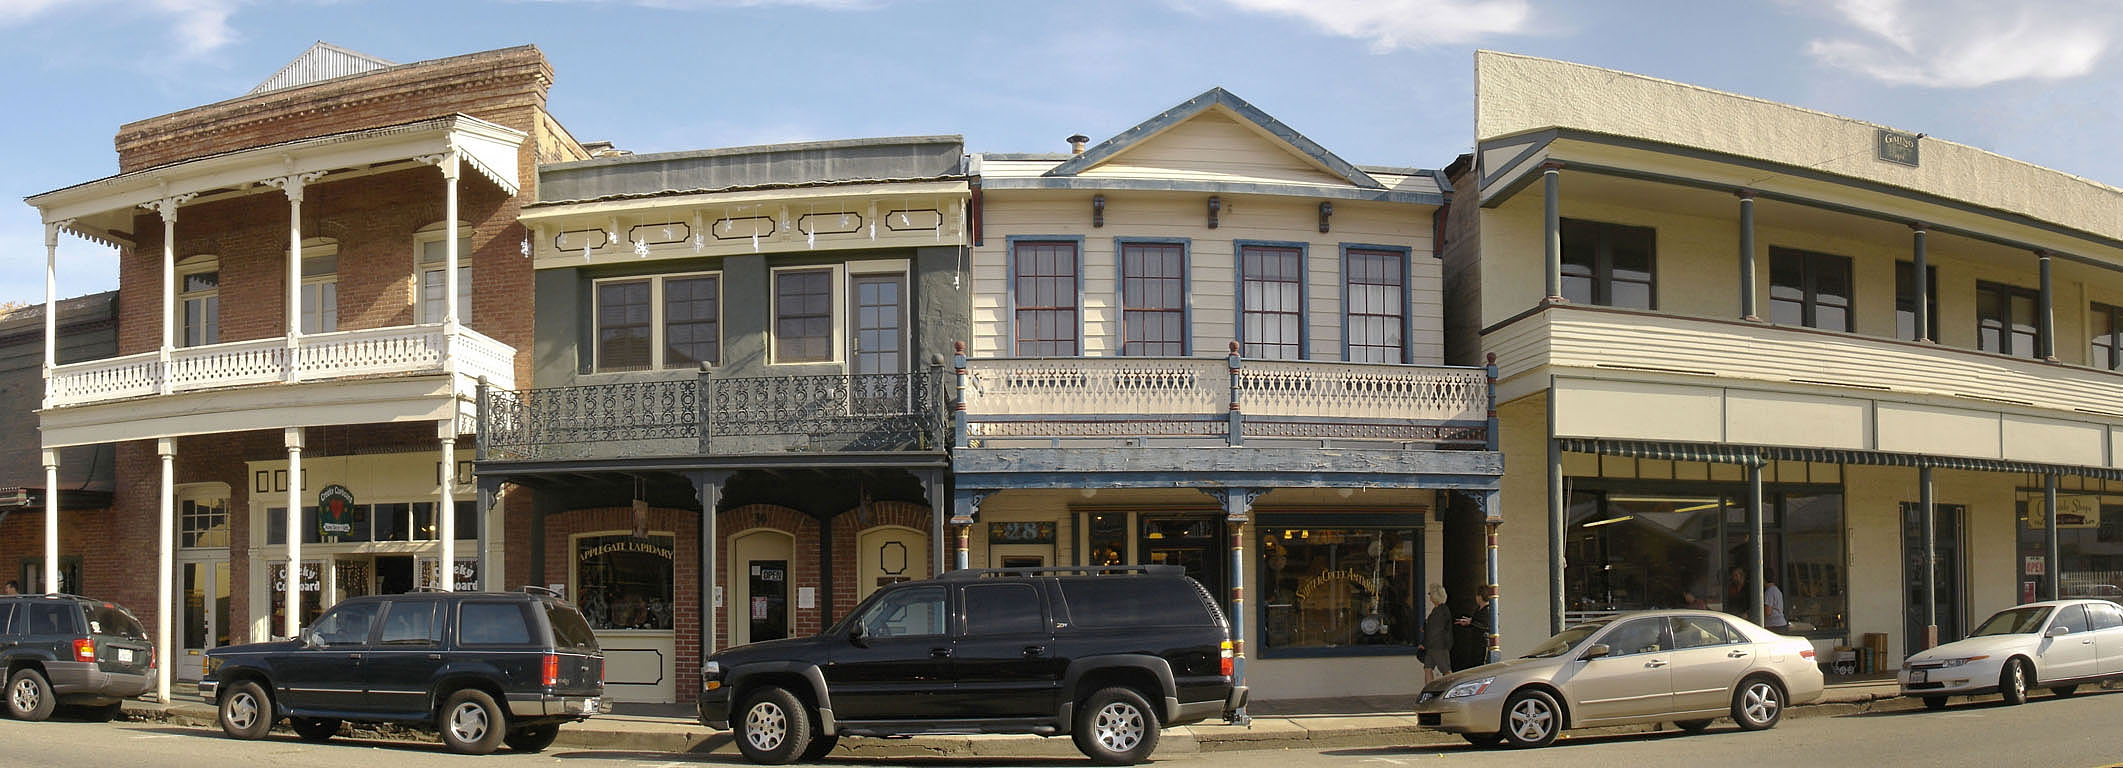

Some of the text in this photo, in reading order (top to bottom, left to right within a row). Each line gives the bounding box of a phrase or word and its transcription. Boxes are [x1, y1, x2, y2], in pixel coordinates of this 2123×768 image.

[580, 542, 674, 561] APPLEGATE LAPIDARY
[763, 570, 782, 580] OPEN
